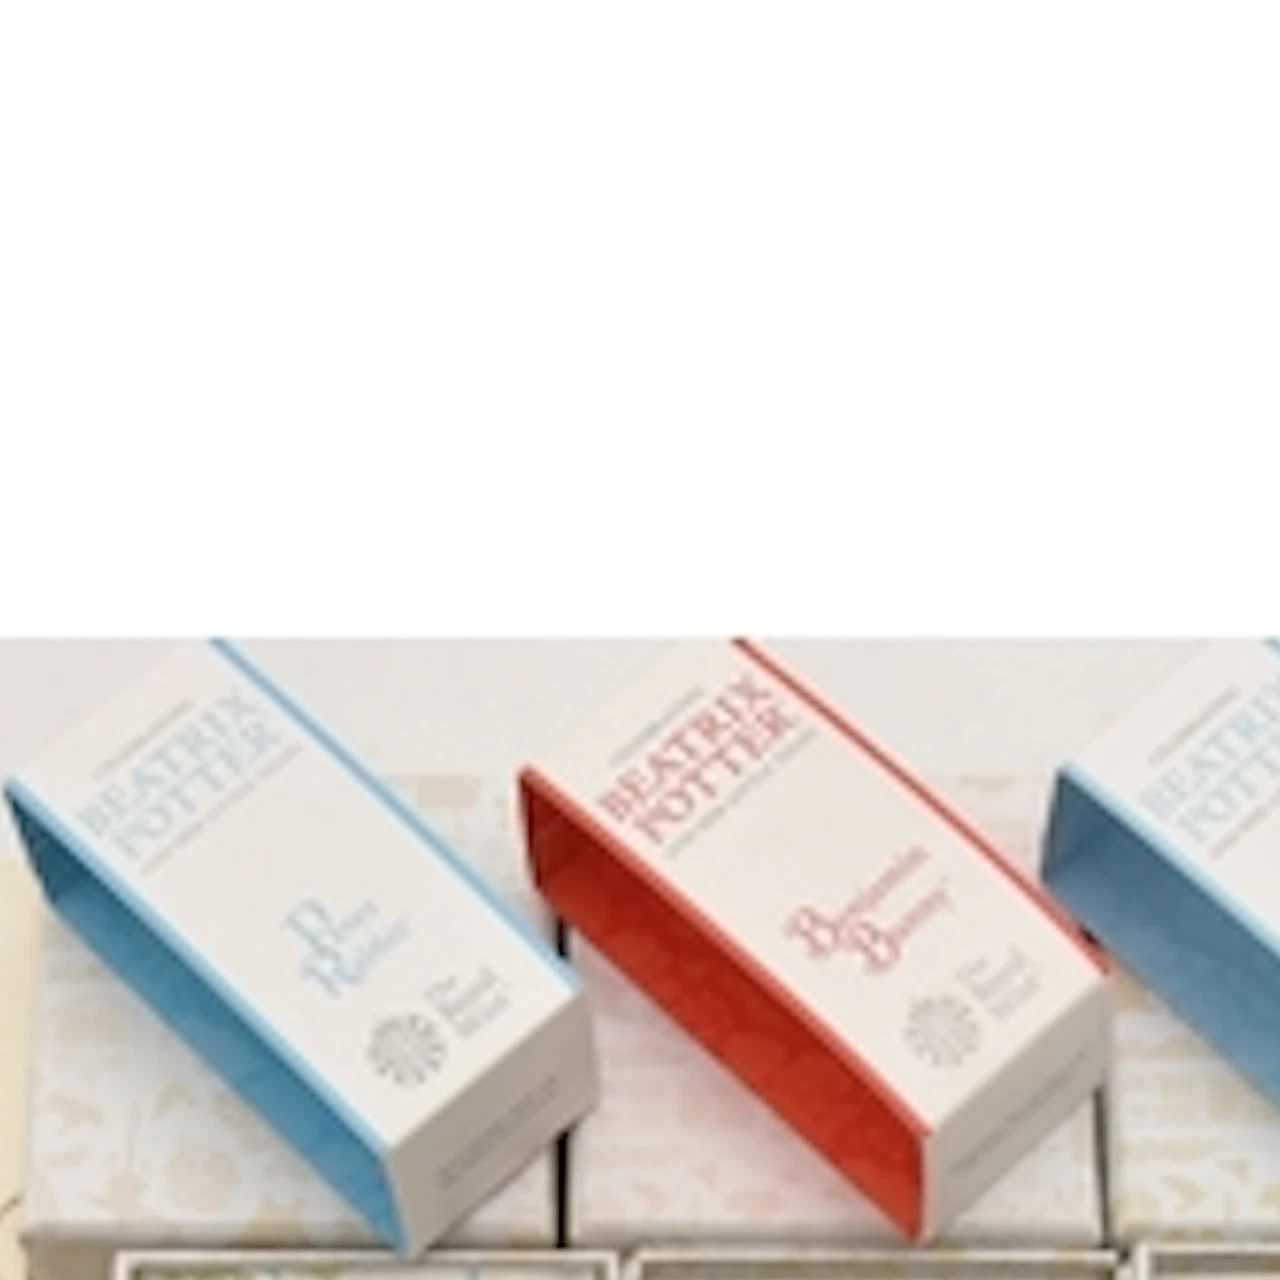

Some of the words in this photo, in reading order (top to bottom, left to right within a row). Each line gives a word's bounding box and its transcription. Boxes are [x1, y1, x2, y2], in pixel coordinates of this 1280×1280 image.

[76, 685, 261, 836] BEATRIX
[111, 720, 286, 858] POTTER
[602, 674, 772, 822] BEATRIX
[630, 703, 797, 846] POTTER
